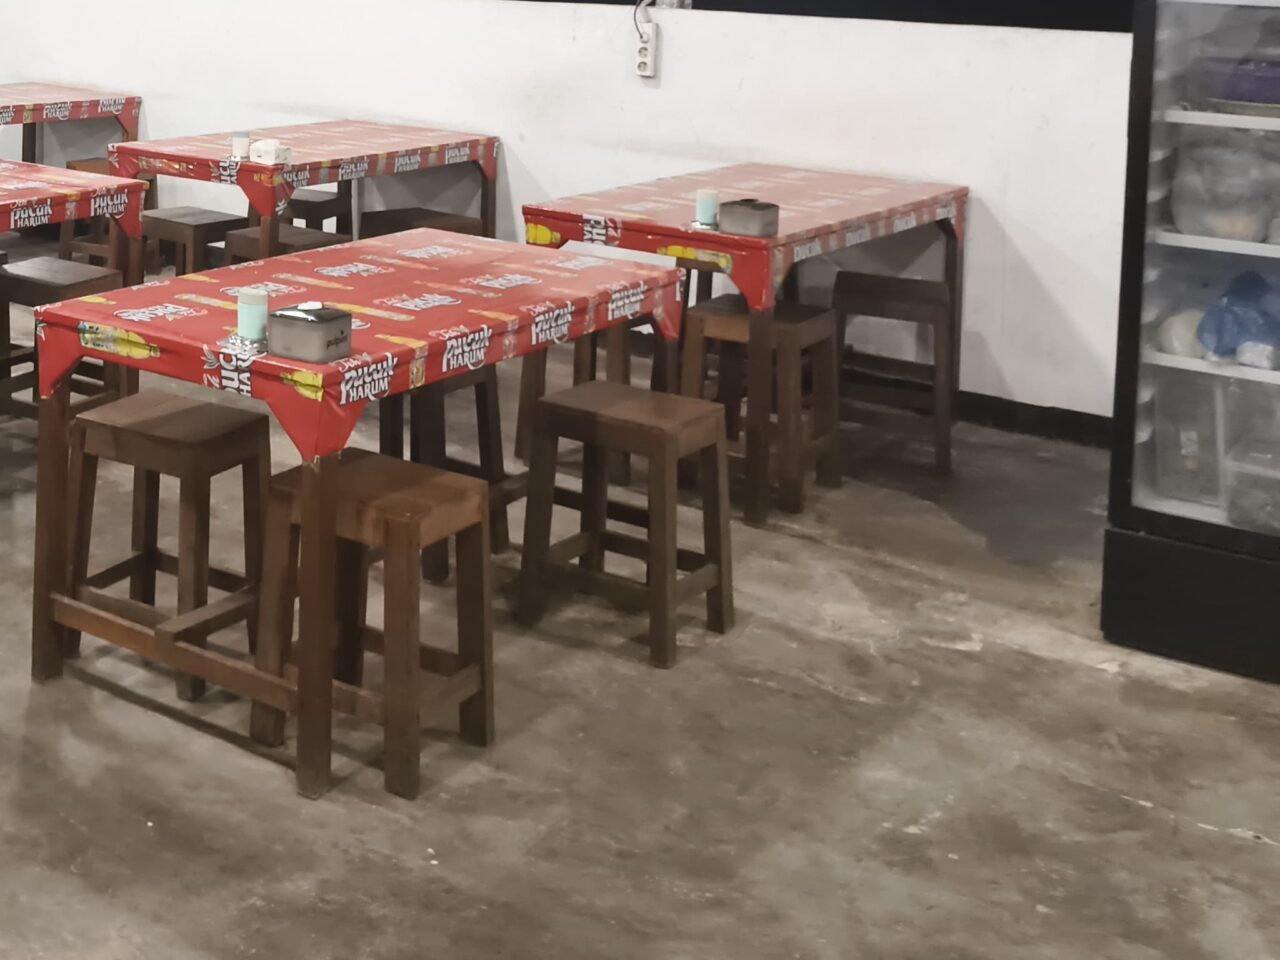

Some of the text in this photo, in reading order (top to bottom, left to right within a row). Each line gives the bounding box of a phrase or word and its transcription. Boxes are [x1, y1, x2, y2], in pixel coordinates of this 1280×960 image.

[97, 203, 125, 217] HARUM
[17, 216, 49, 228] HARUM
[539, 325, 568, 343] HARUM
[450, 349, 486, 370] HARUM
[350, 377, 390, 401] HARUM
